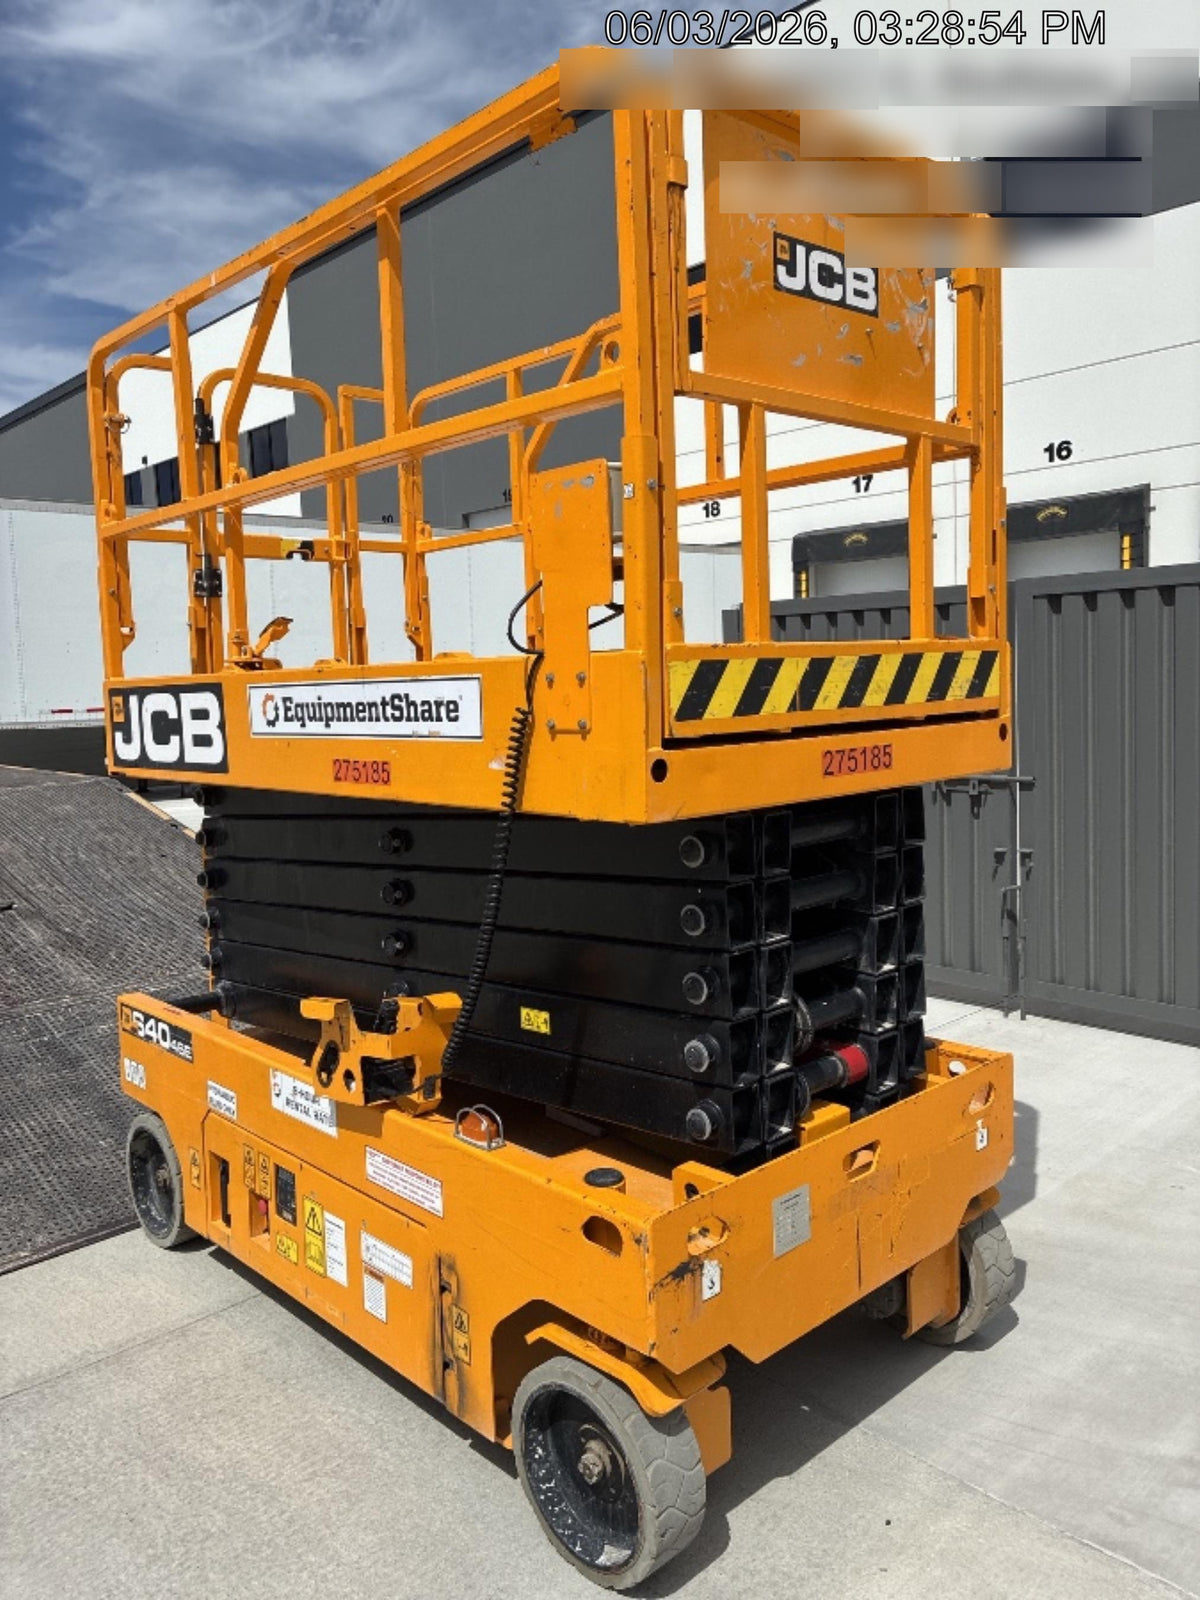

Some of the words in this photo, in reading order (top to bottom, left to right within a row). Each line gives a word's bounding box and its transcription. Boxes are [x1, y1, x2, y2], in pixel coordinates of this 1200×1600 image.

[776, 244, 878, 311] JCB
[1043, 440, 1073, 463] 16
[852, 474, 874, 493] 17
[702, 501, 721, 518] 18
[281, 693, 460, 729] EquipmentShare
[114, 690, 225, 765] JCB
[333, 759, 391, 785] 275185
[823, 744, 893, 776] 275185
